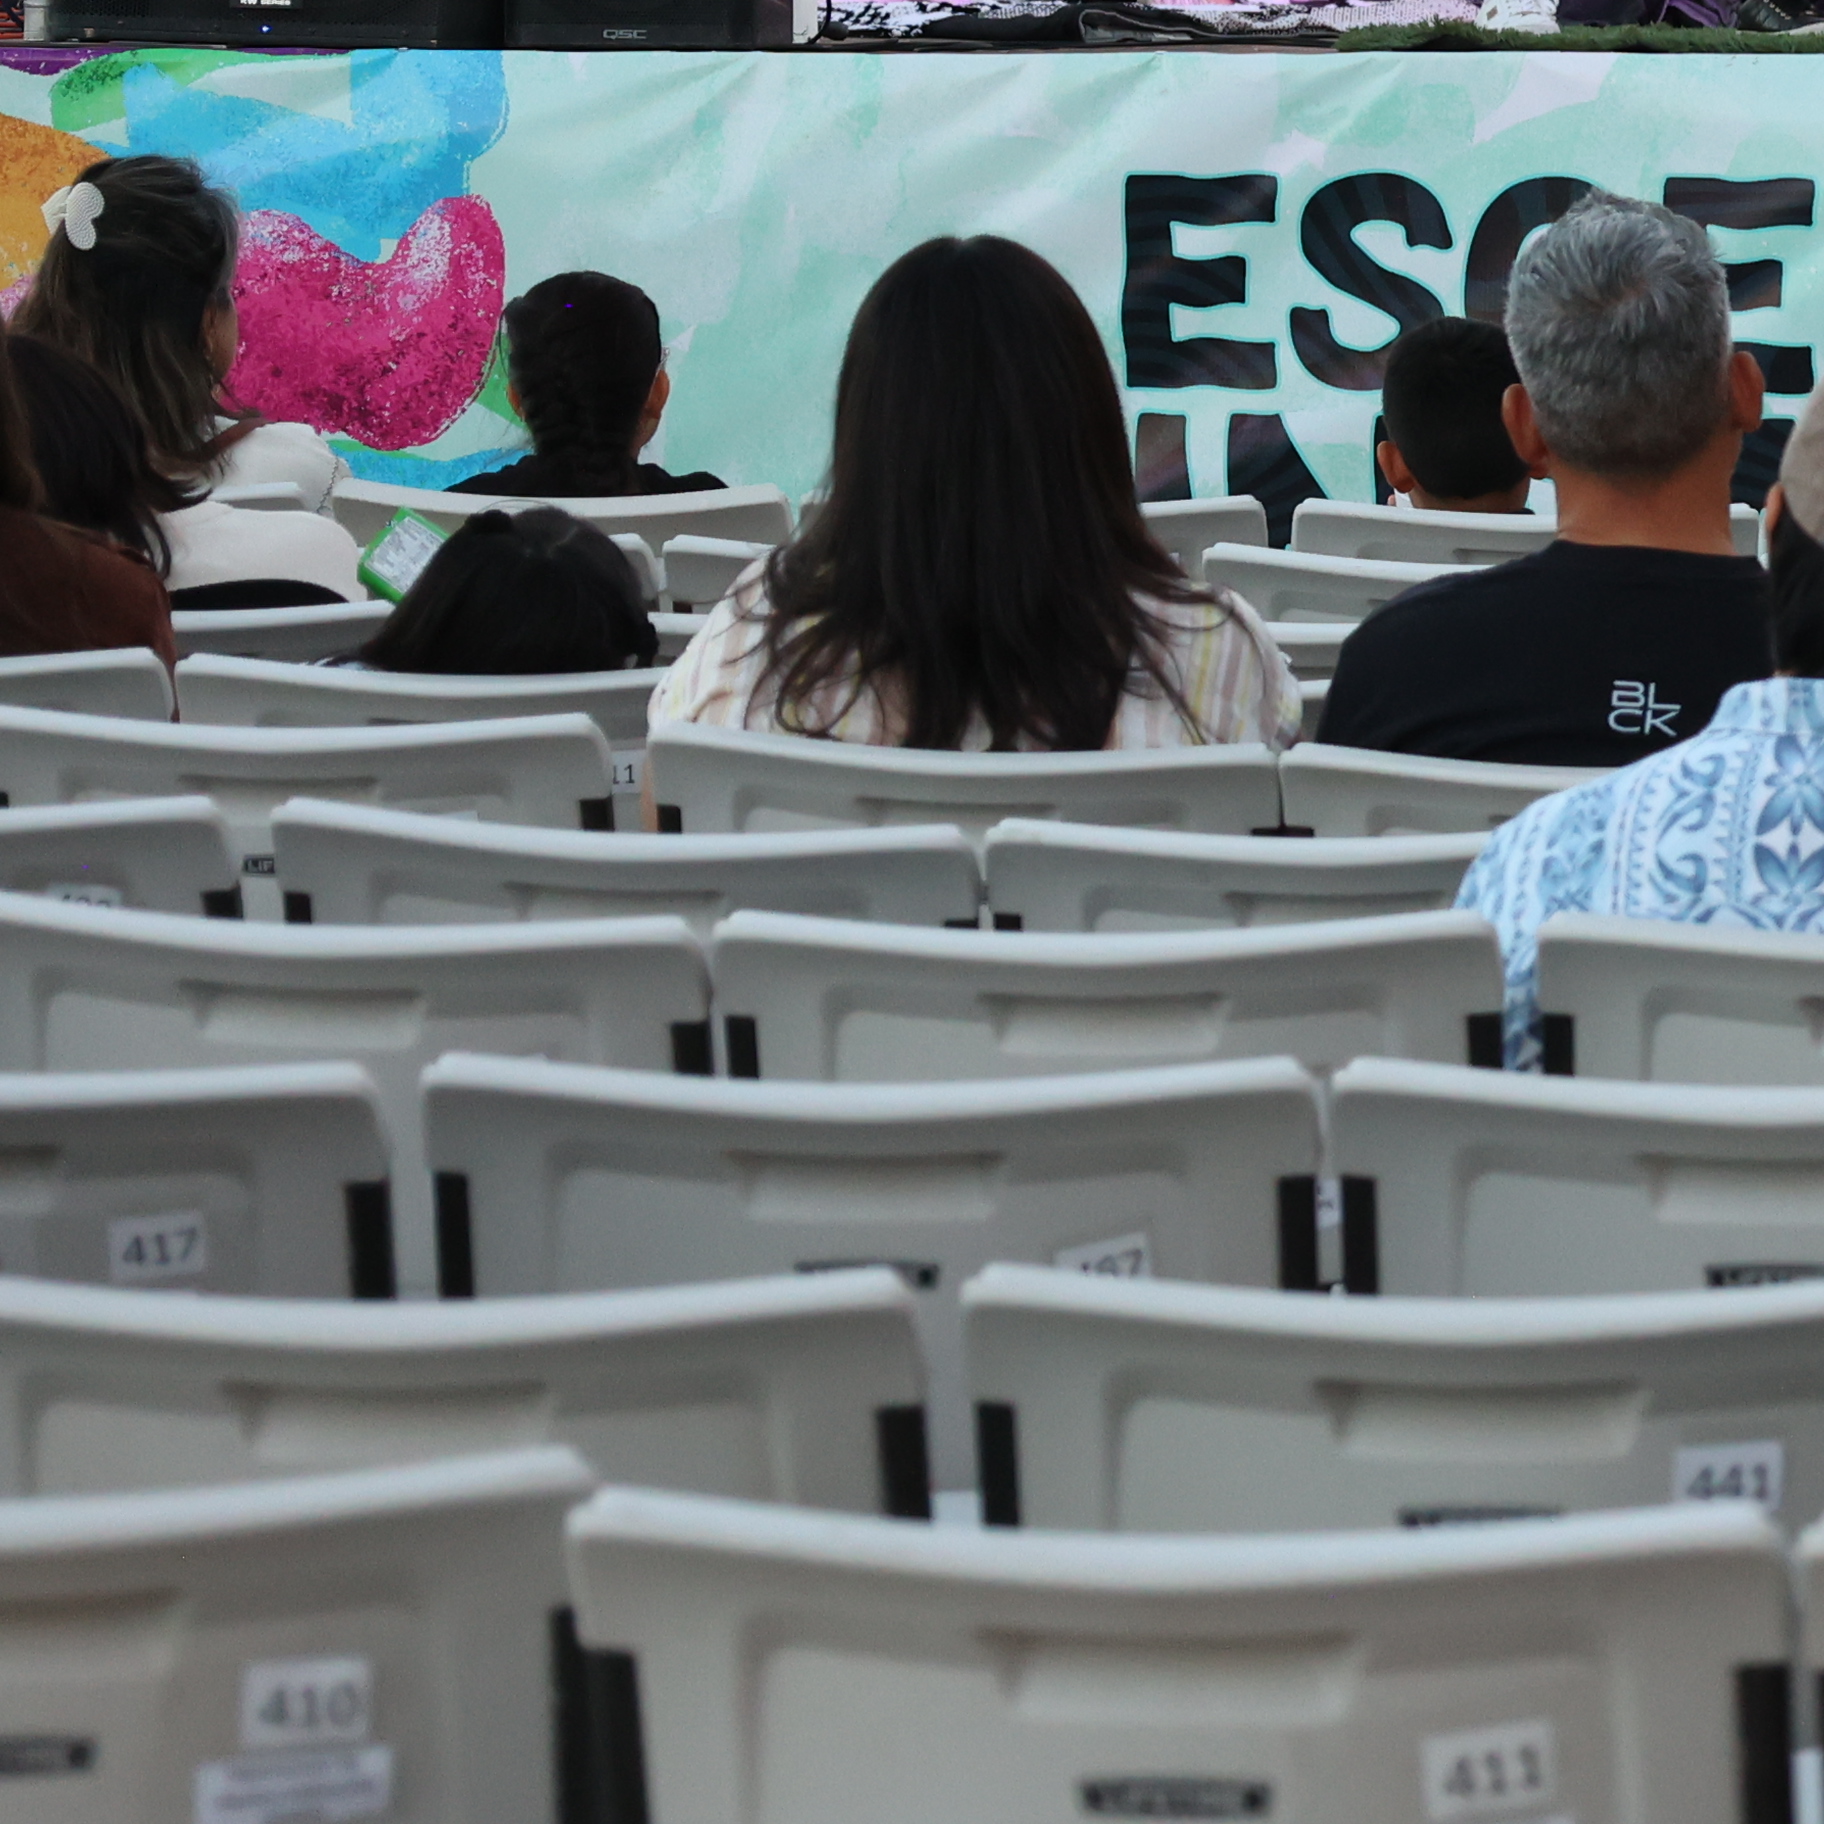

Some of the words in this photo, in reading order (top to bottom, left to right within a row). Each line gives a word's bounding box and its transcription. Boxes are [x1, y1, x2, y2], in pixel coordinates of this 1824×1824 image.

[603, 29, 647, 40] QSC
[122, 1227, 197, 1265] 417
[1686, 1462, 1769, 1500] 441
[258, 1682, 360, 1728] 410
[1443, 1744, 1542, 1798] 411
